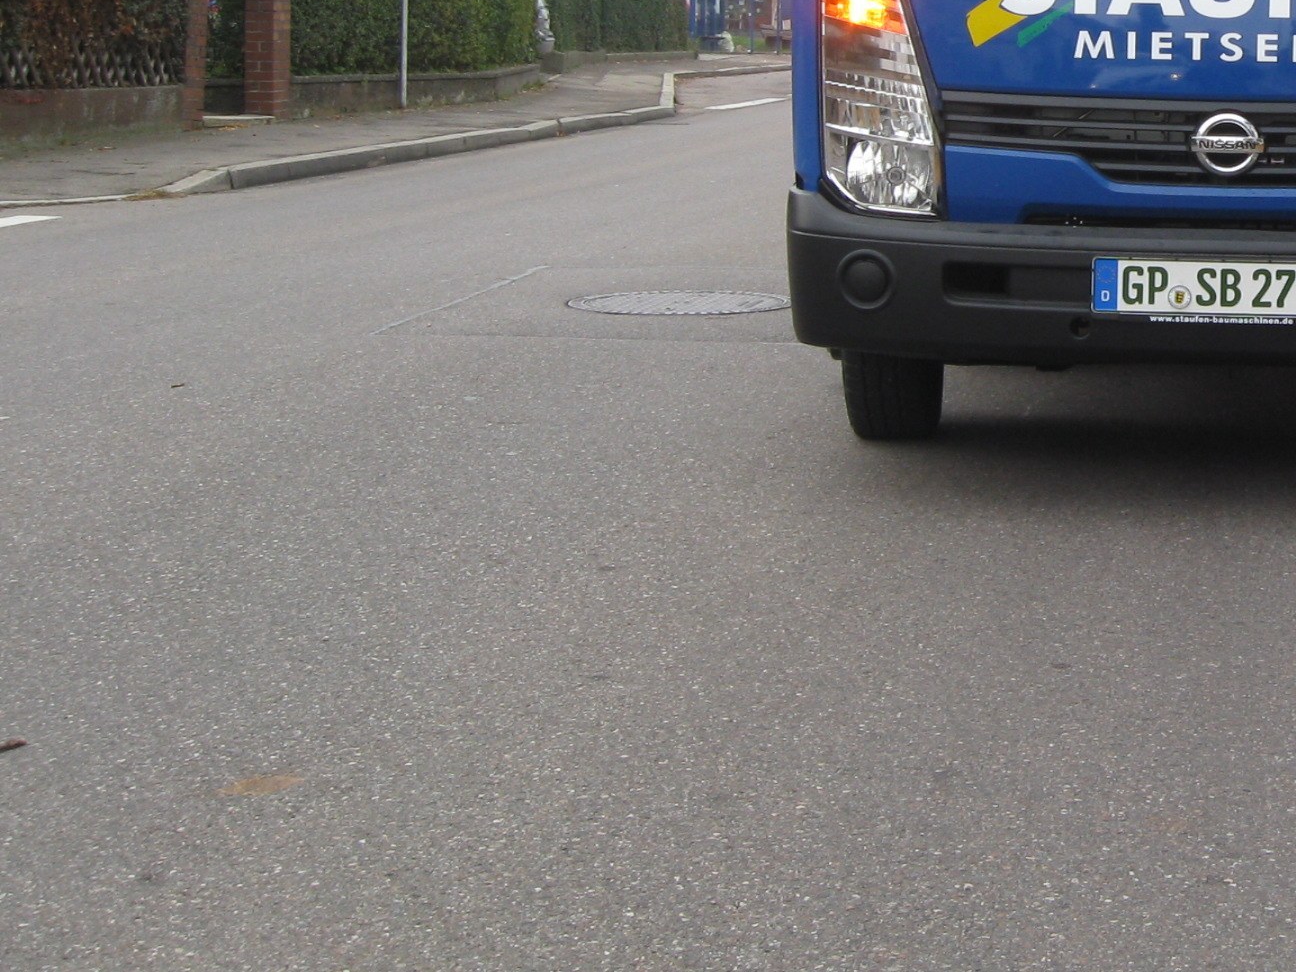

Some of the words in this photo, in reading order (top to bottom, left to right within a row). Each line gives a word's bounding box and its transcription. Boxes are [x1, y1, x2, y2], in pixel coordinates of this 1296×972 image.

[1198, 140, 1254, 150] NISSAN
[1122, 266, 1169, 305] GP
[1195, 268, 1242, 307] SB
[1149, 314, 1294, 325] www.staufen-baumaschinen.de
